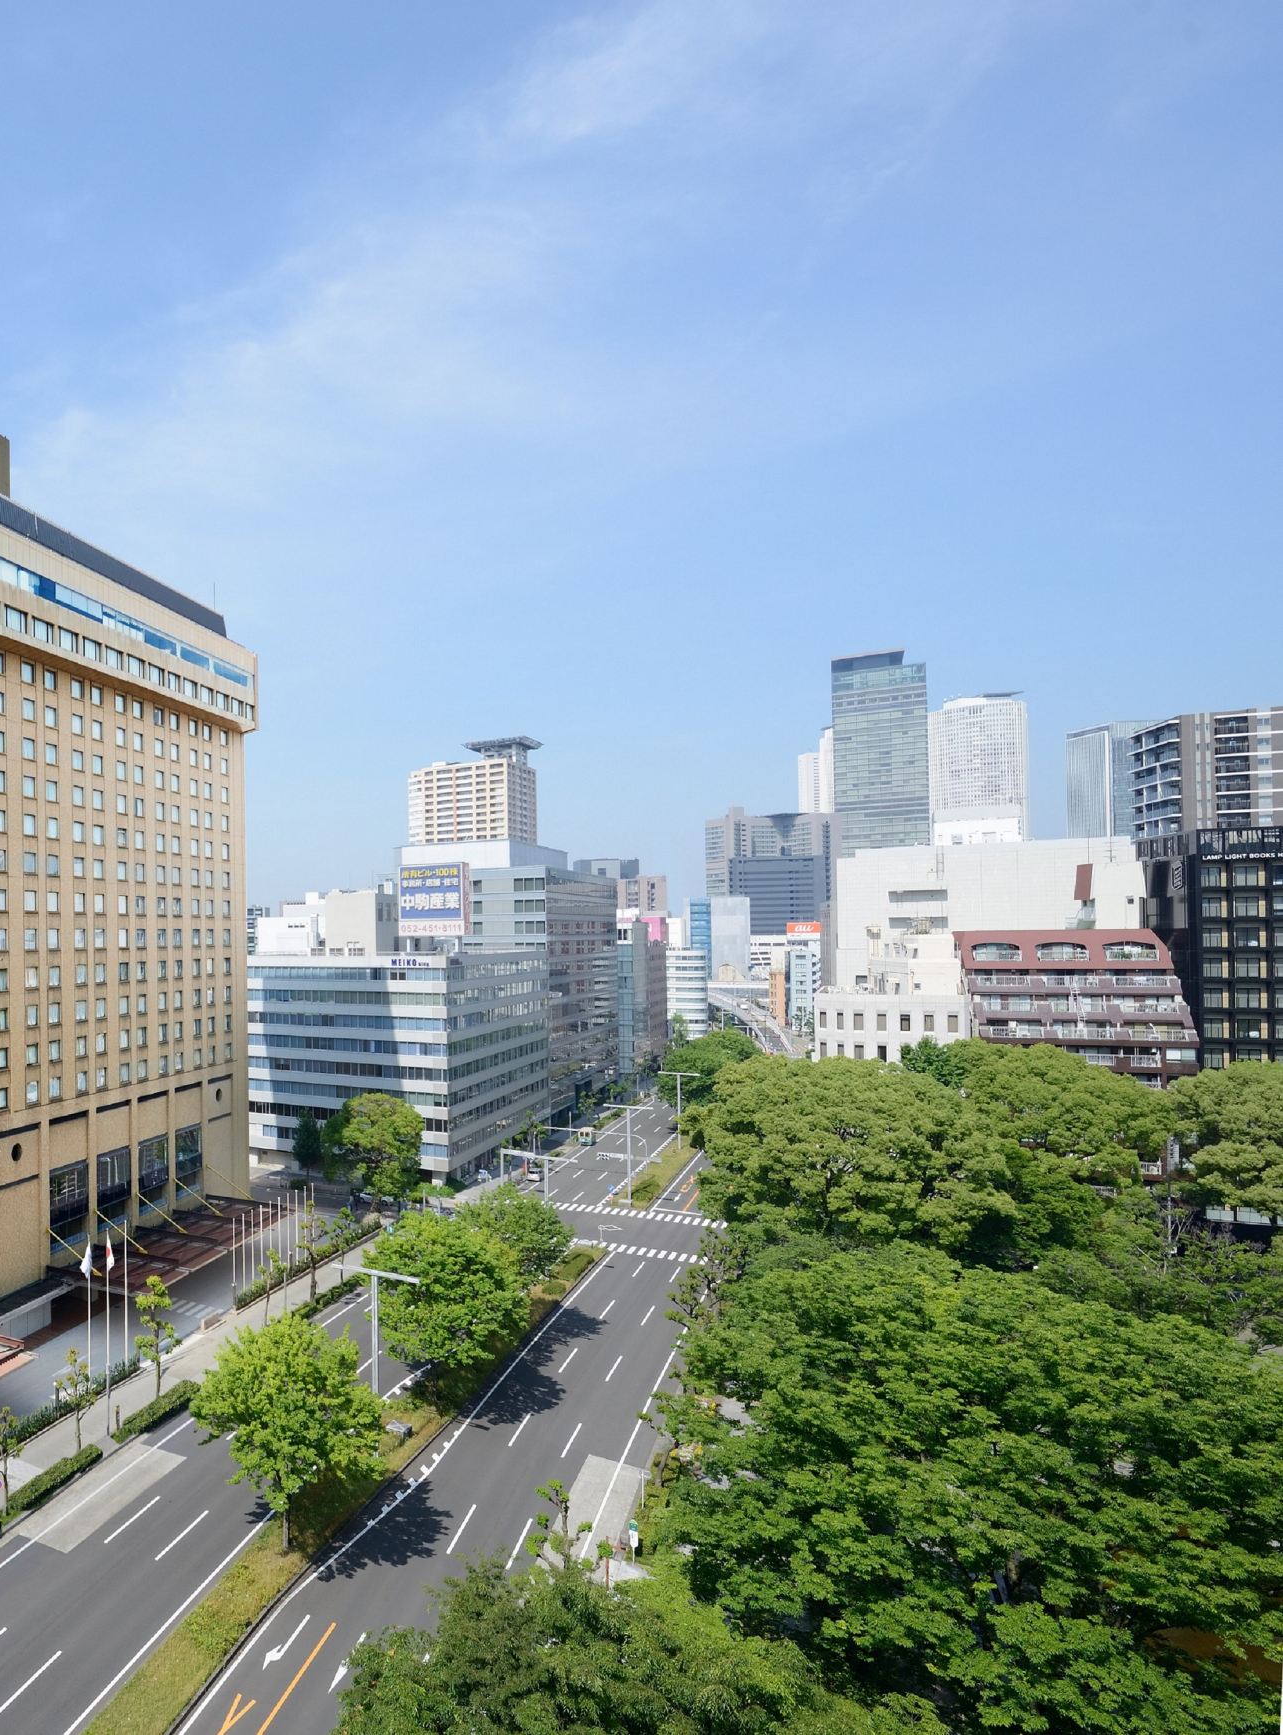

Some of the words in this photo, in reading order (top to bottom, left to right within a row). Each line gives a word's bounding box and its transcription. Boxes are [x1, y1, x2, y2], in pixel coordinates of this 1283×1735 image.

[401, 892, 460, 911] 中駒産業
[795, 924, 814, 932] au
[391, 958, 417, 967] MEIKO
